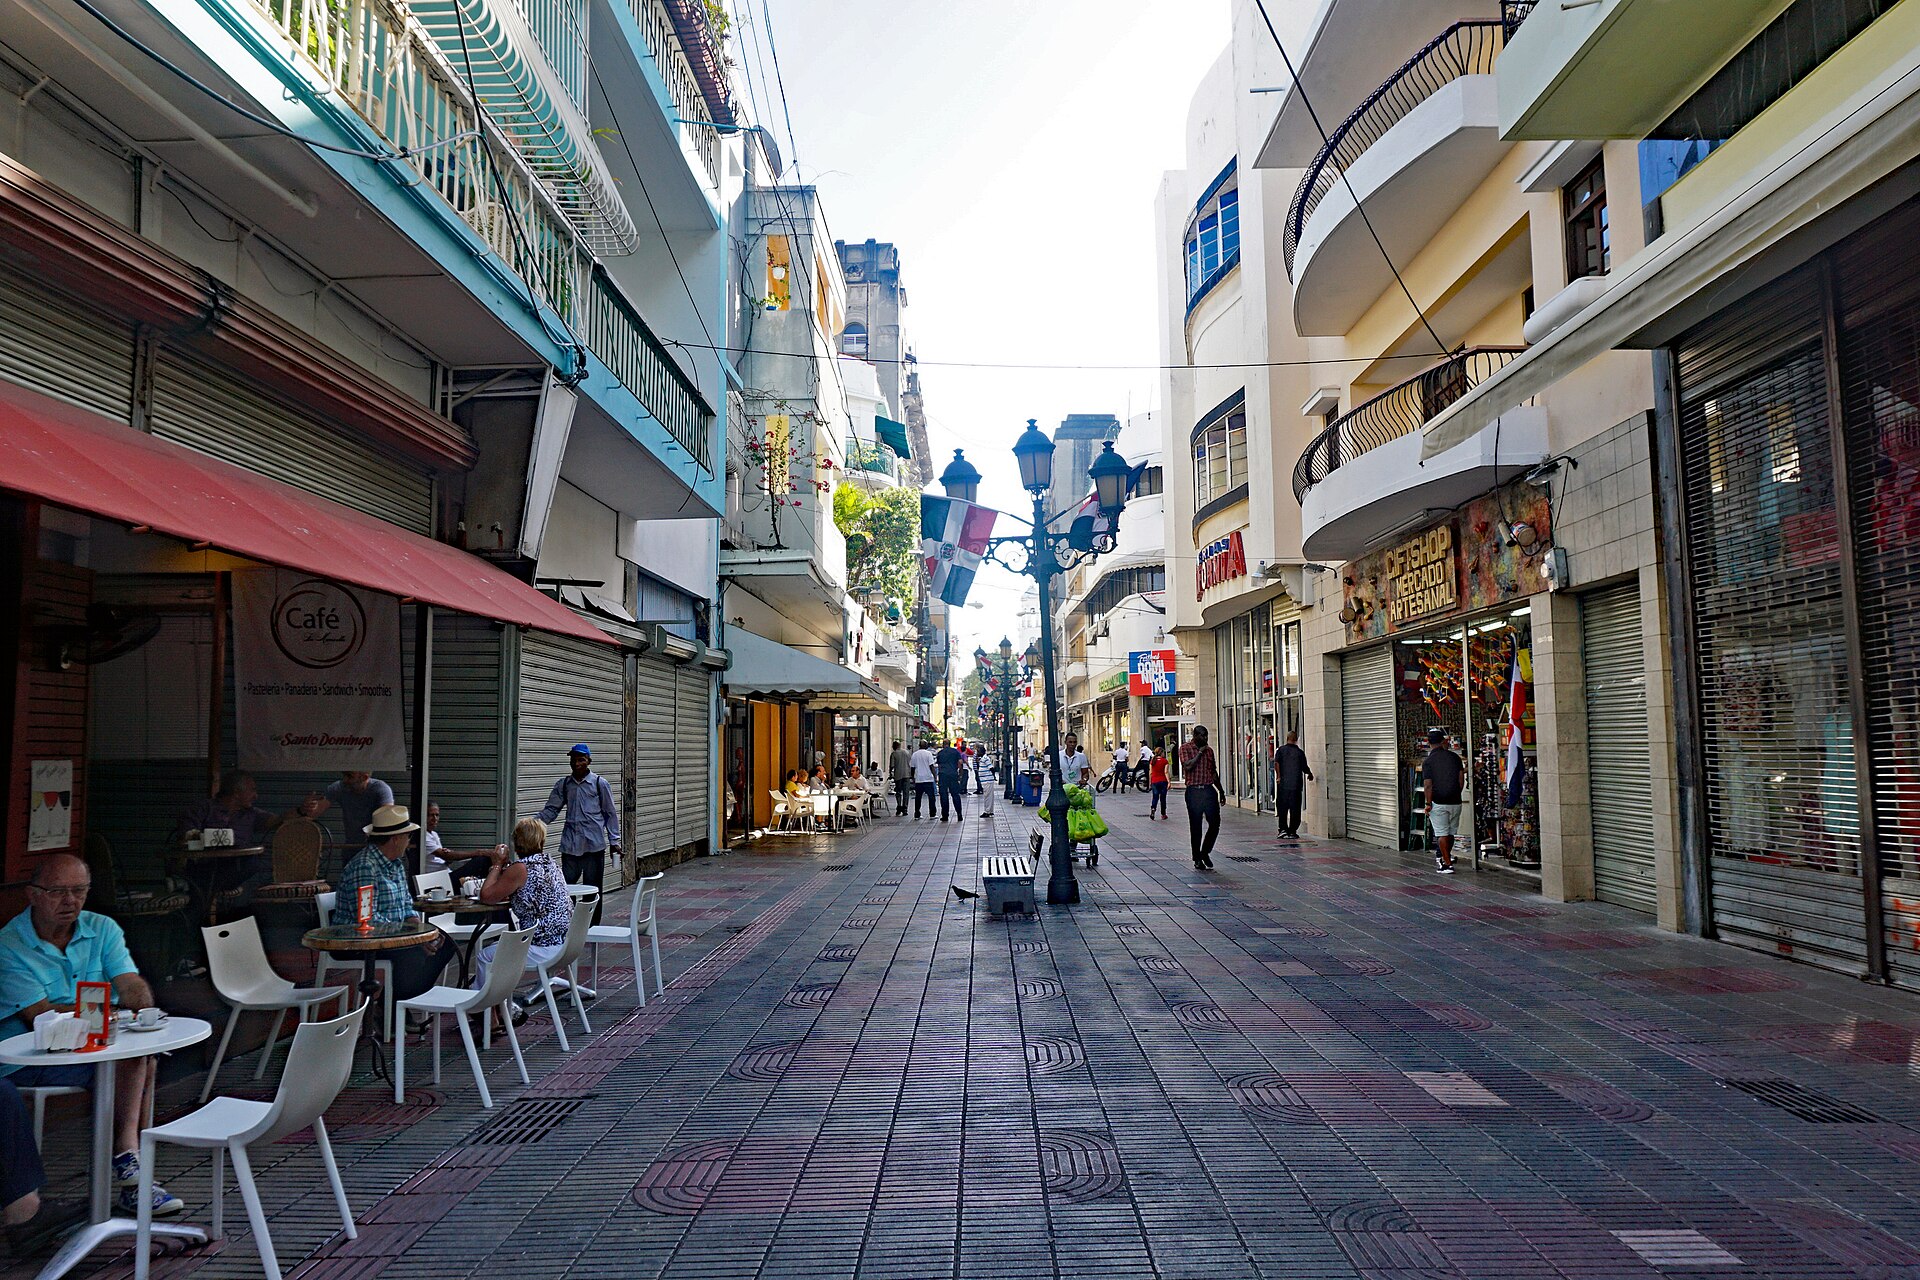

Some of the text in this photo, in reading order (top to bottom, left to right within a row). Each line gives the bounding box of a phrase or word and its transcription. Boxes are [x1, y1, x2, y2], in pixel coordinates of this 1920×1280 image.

[1396, 561, 1444, 598] MERCADO
[1390, 581, 1455, 622] ARTESANAL
[286, 607, 340, 629] Café
[1138, 660, 1165, 674] DOMI
[1141, 672, 1166, 685] NICA
[1154, 680, 1170, 693] NO
[322, 682, 354, 696] Sandwich
[358, 683, 392, 697] Smoothies
[281, 732, 319, 747] Santo
[319, 732, 374, 750] Domingo
